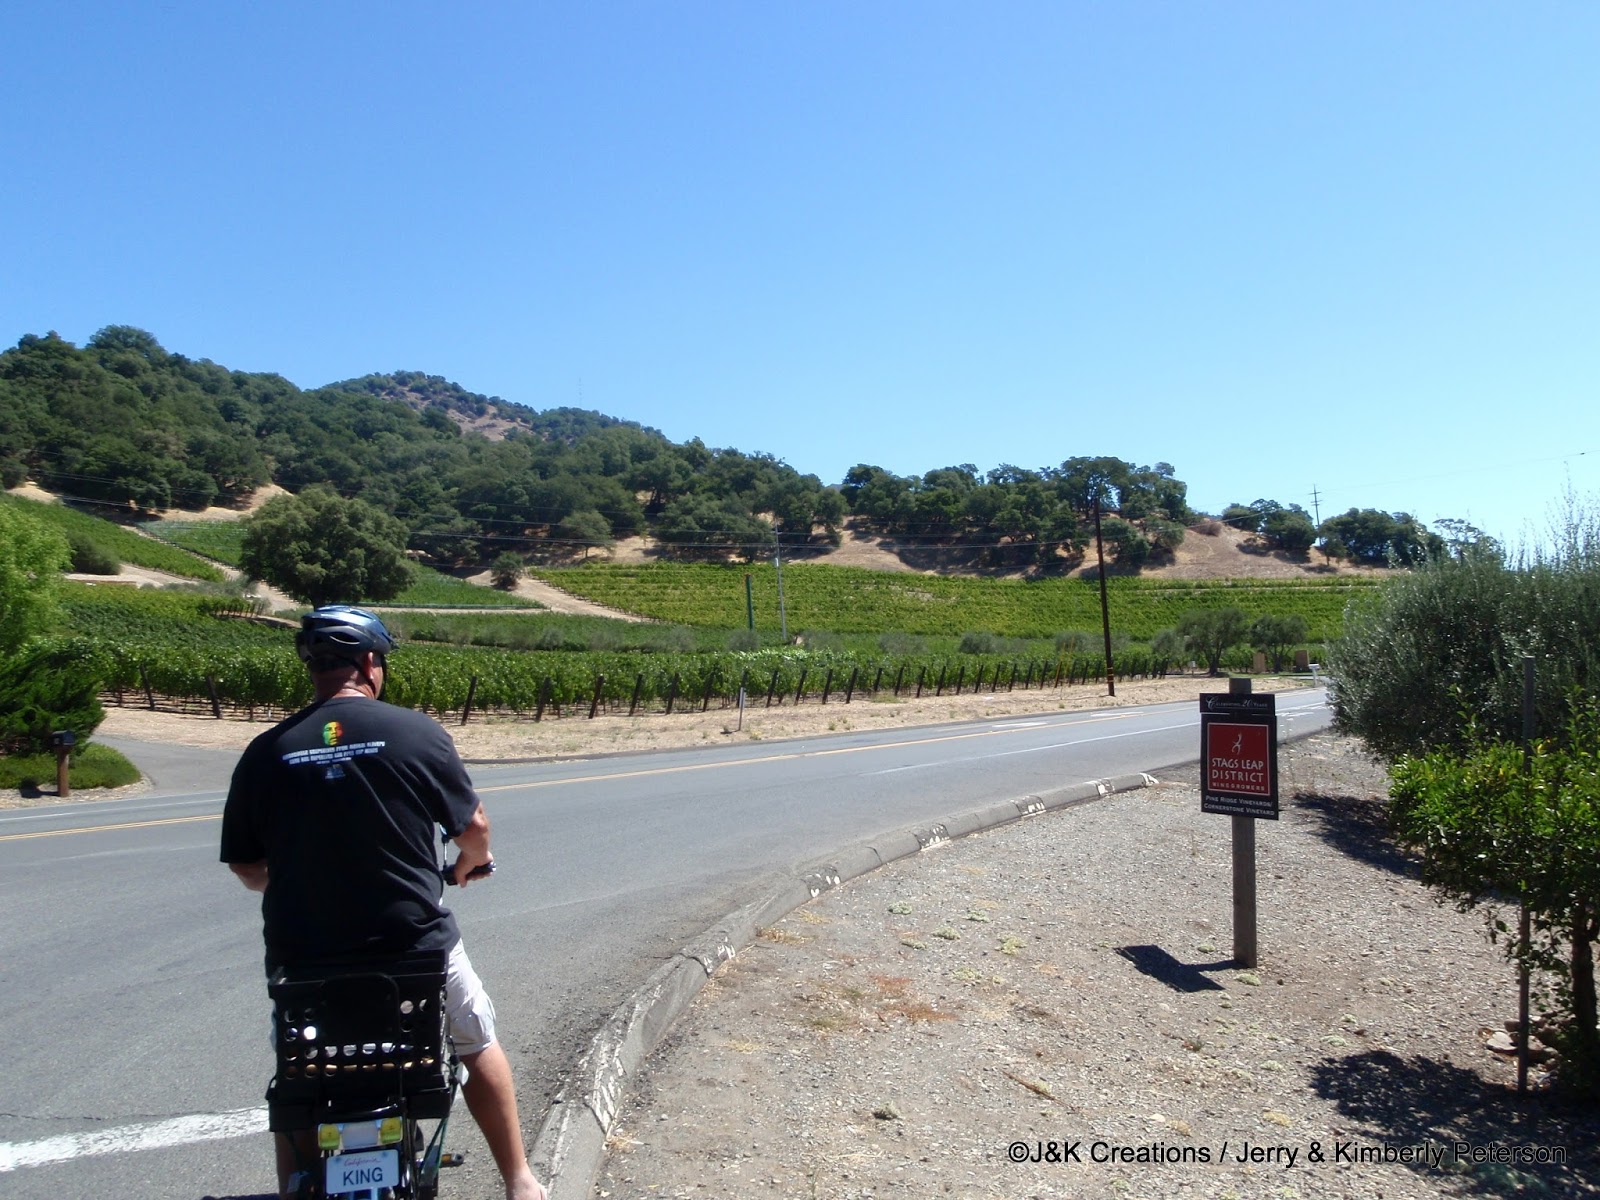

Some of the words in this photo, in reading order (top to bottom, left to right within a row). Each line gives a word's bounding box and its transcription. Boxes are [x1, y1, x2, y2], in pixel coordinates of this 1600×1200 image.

[1212, 757, 1239, 769] STAGS
[1241, 759, 1264, 771] LEAP
[1212, 769, 1264, 783] DISTRICT
[1212, 782, 1265, 791] WINEGROWERS
[343, 1166, 383, 1186] KING
